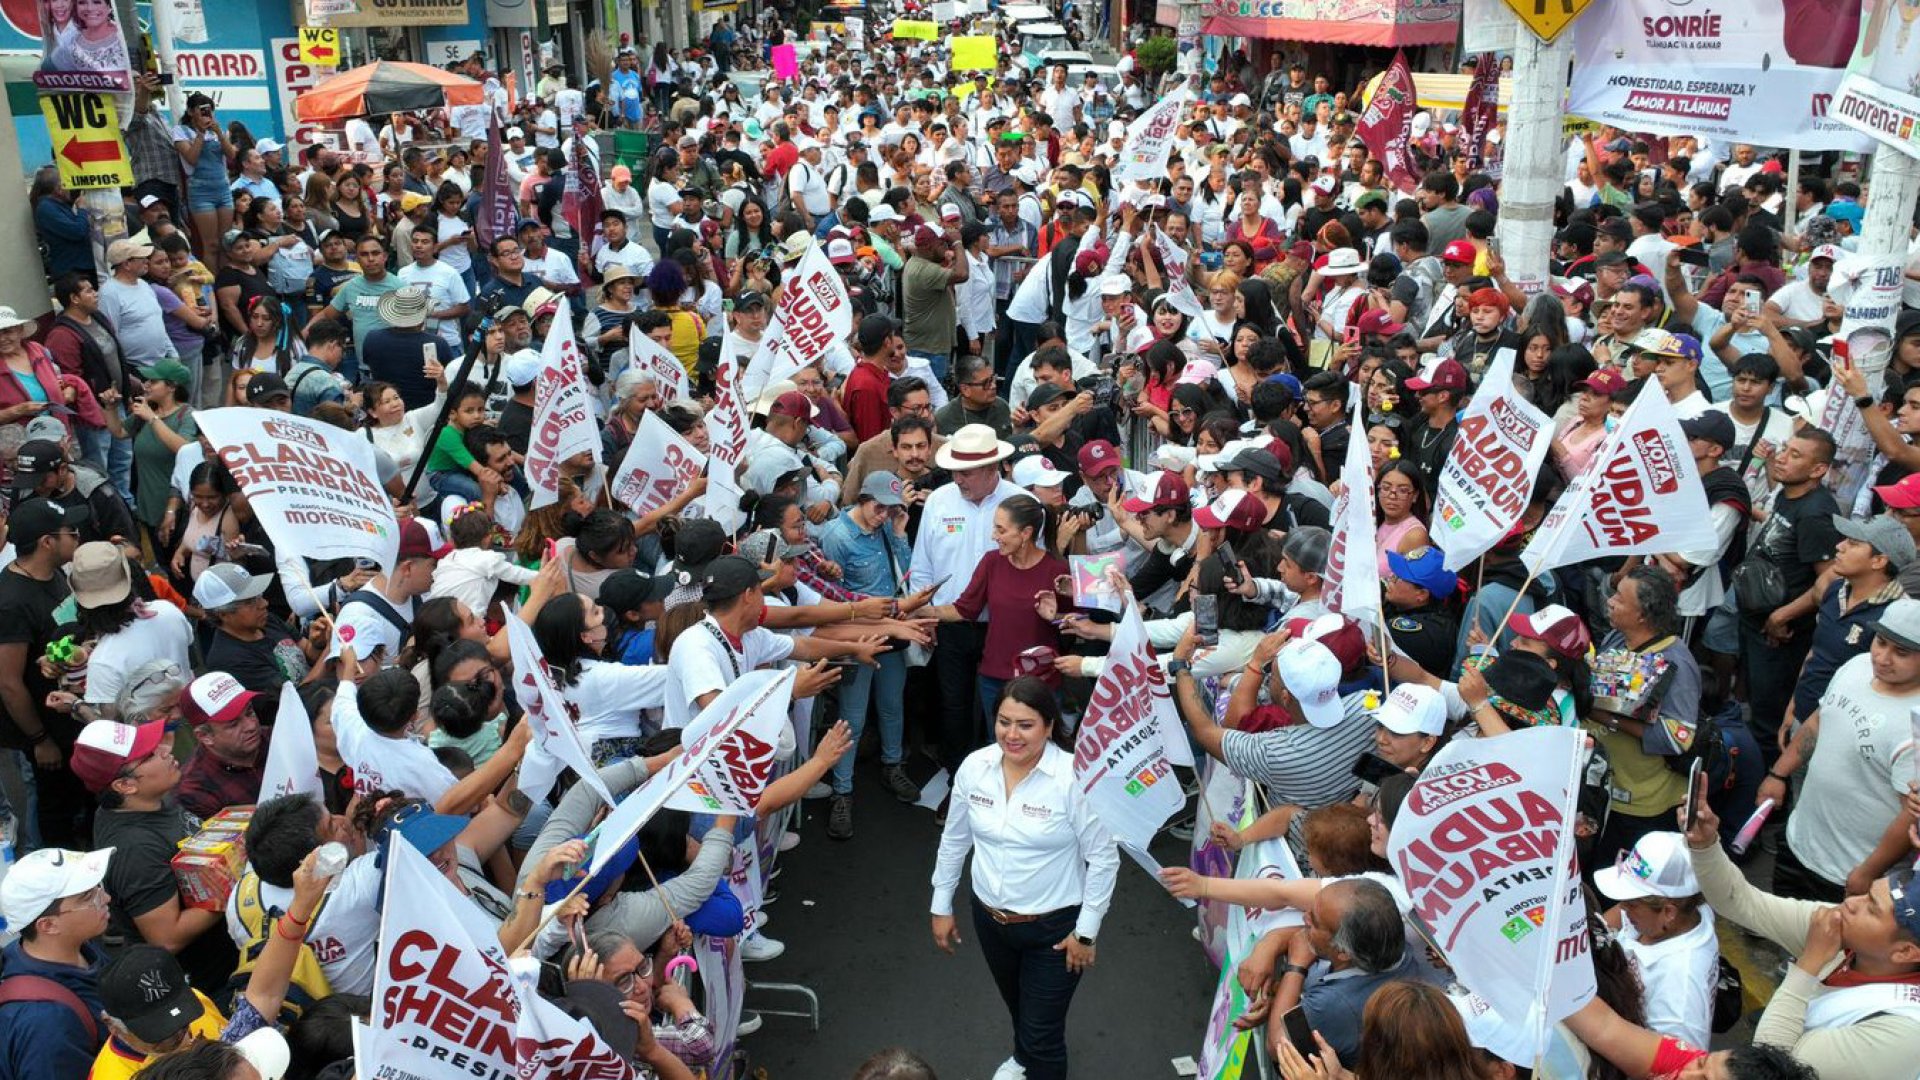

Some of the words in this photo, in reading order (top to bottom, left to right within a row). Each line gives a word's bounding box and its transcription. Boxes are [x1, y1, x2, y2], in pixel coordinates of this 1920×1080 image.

[304, 29, 334, 42] WC
[1644, 9, 1721, 38] SONRÍE
[1696, 41, 1721, 49] GANAR
[48, 72, 114, 88] morena
[1607, 75, 1684, 93] HONESTIDAD,
[1686, 80, 1745, 96] ESPERANZA
[1748, 84, 1756, 96] Y
[51, 93, 108, 130] WC
[1628, 95, 1664, 111] AMOR
[1665, 99, 1676, 112] A
[1678, 98, 1730, 117] TLÁHUAC
[1839, 94, 1900, 135] morena
[71, 174, 121, 187] LIMPIOS
[1500, 404, 1533, 441] VOTA
[1665, 440, 1676, 452] DE
[218, 443, 381, 493] CLAUDIA
[1648, 437, 1671, 484] VOTA
[1670, 452, 1685, 480] JUNIO
[231, 464, 388, 511] SHEINBAUM
[277, 485, 371, 512] PRESIDENTA
[284, 510, 364, 531] morena
